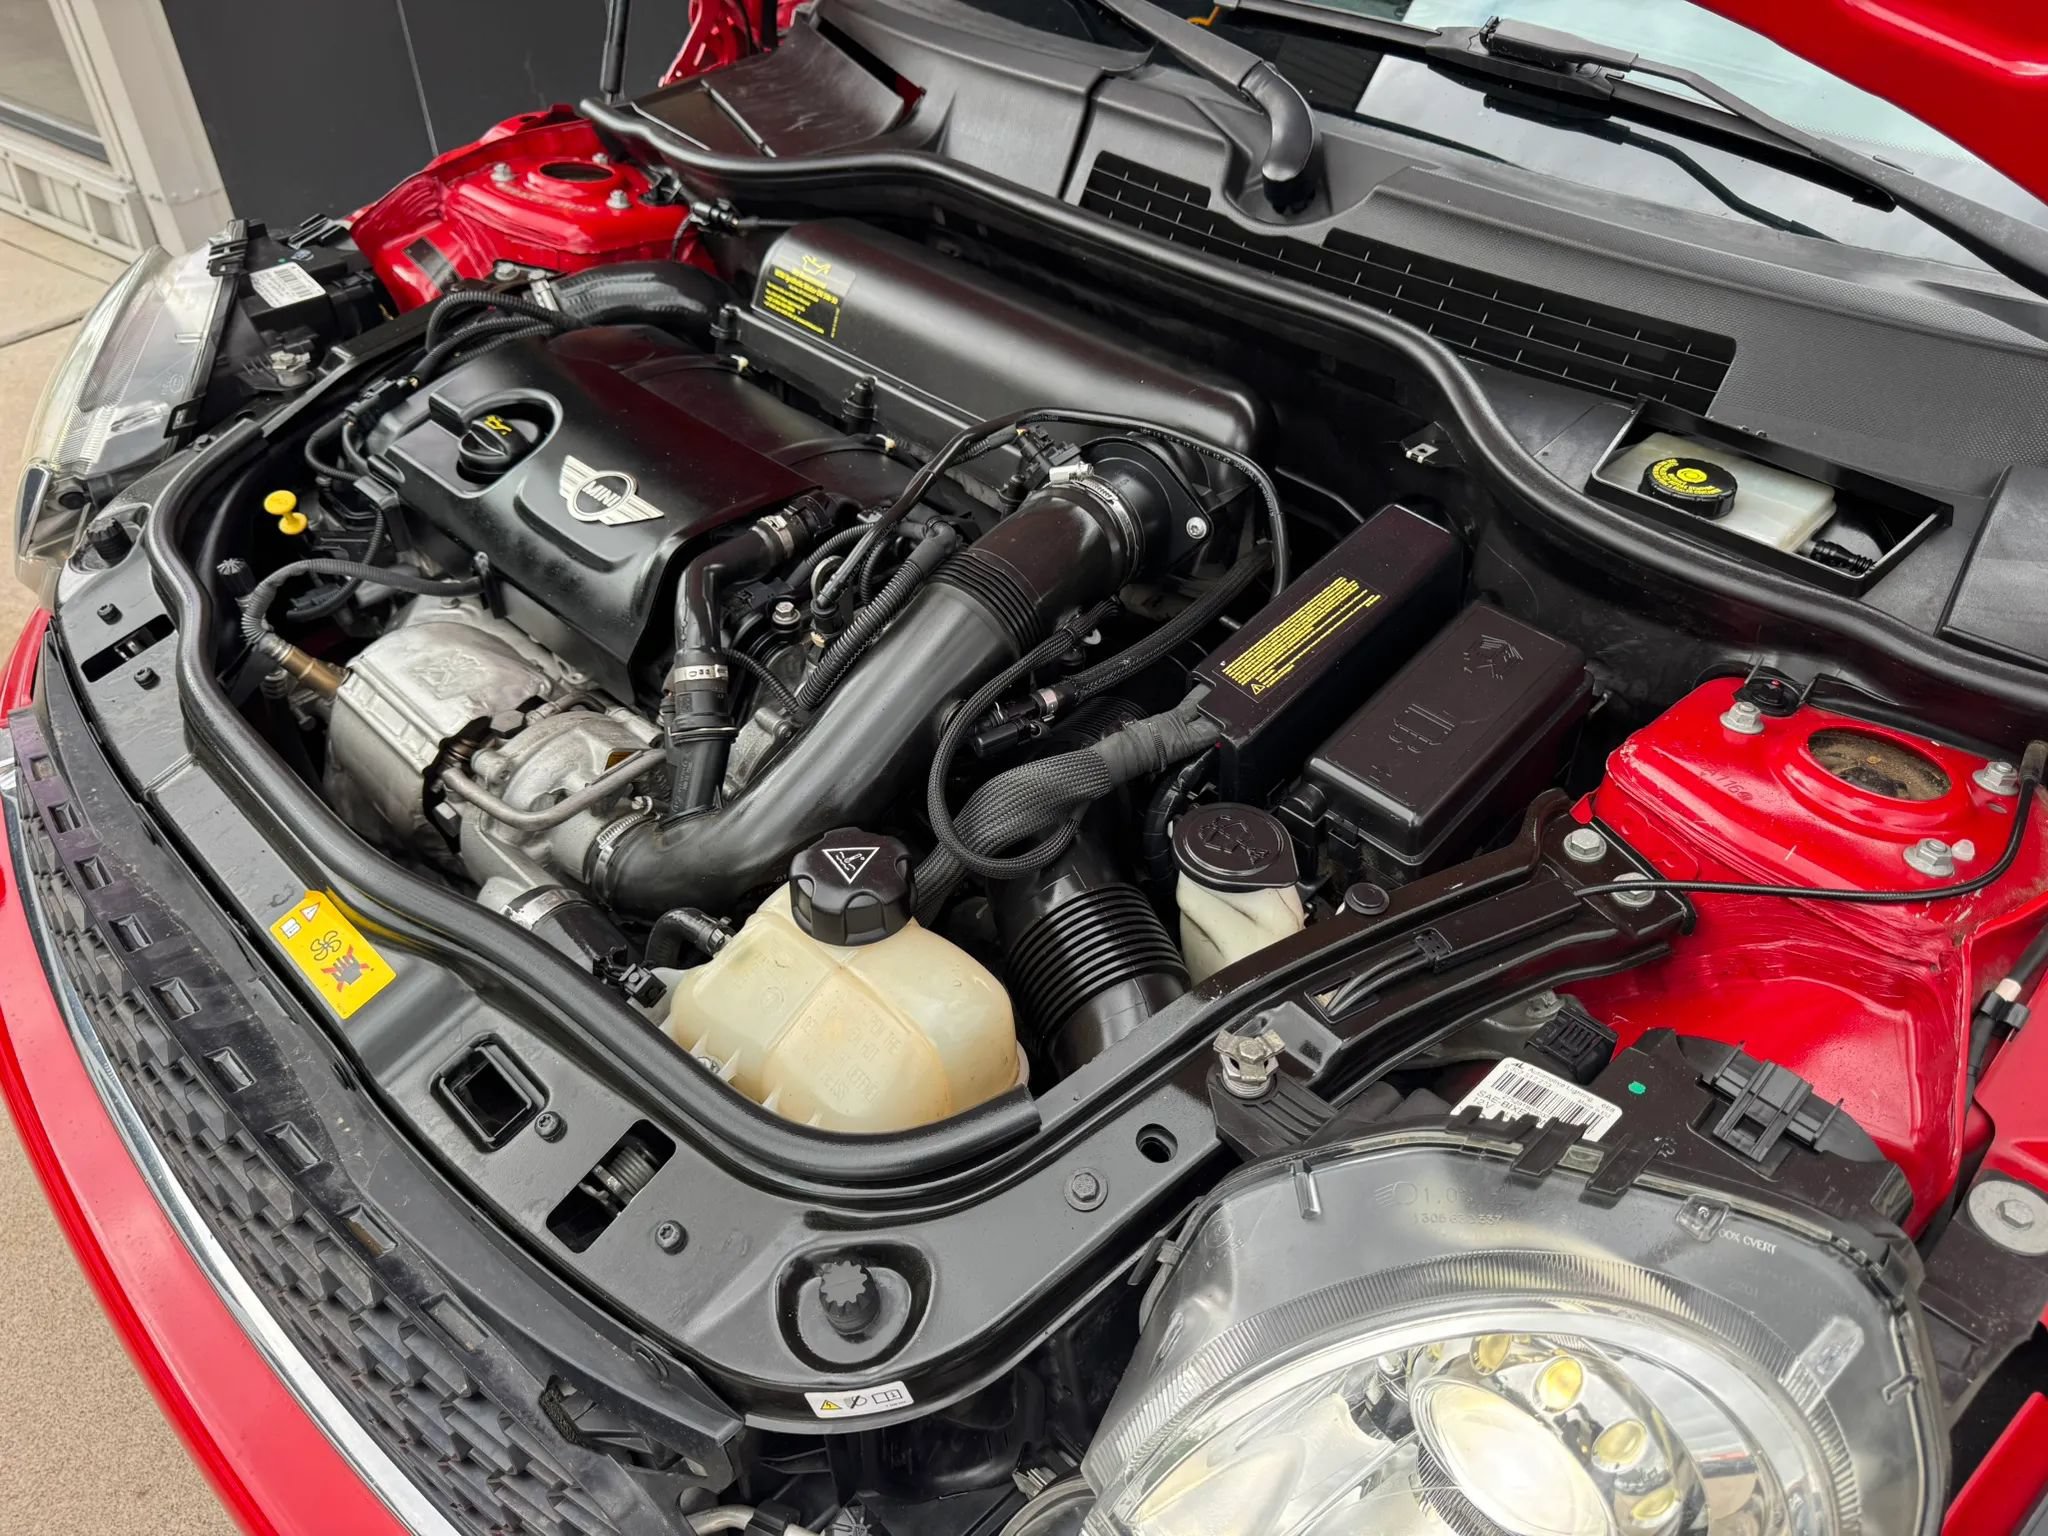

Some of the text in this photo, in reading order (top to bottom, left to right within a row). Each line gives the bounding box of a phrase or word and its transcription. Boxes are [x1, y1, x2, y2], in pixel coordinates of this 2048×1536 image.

[582, 480, 621, 508] MINI
[1529, 1068, 1565, 1088] Automotive
[1566, 1086, 1594, 1102] Lighting
